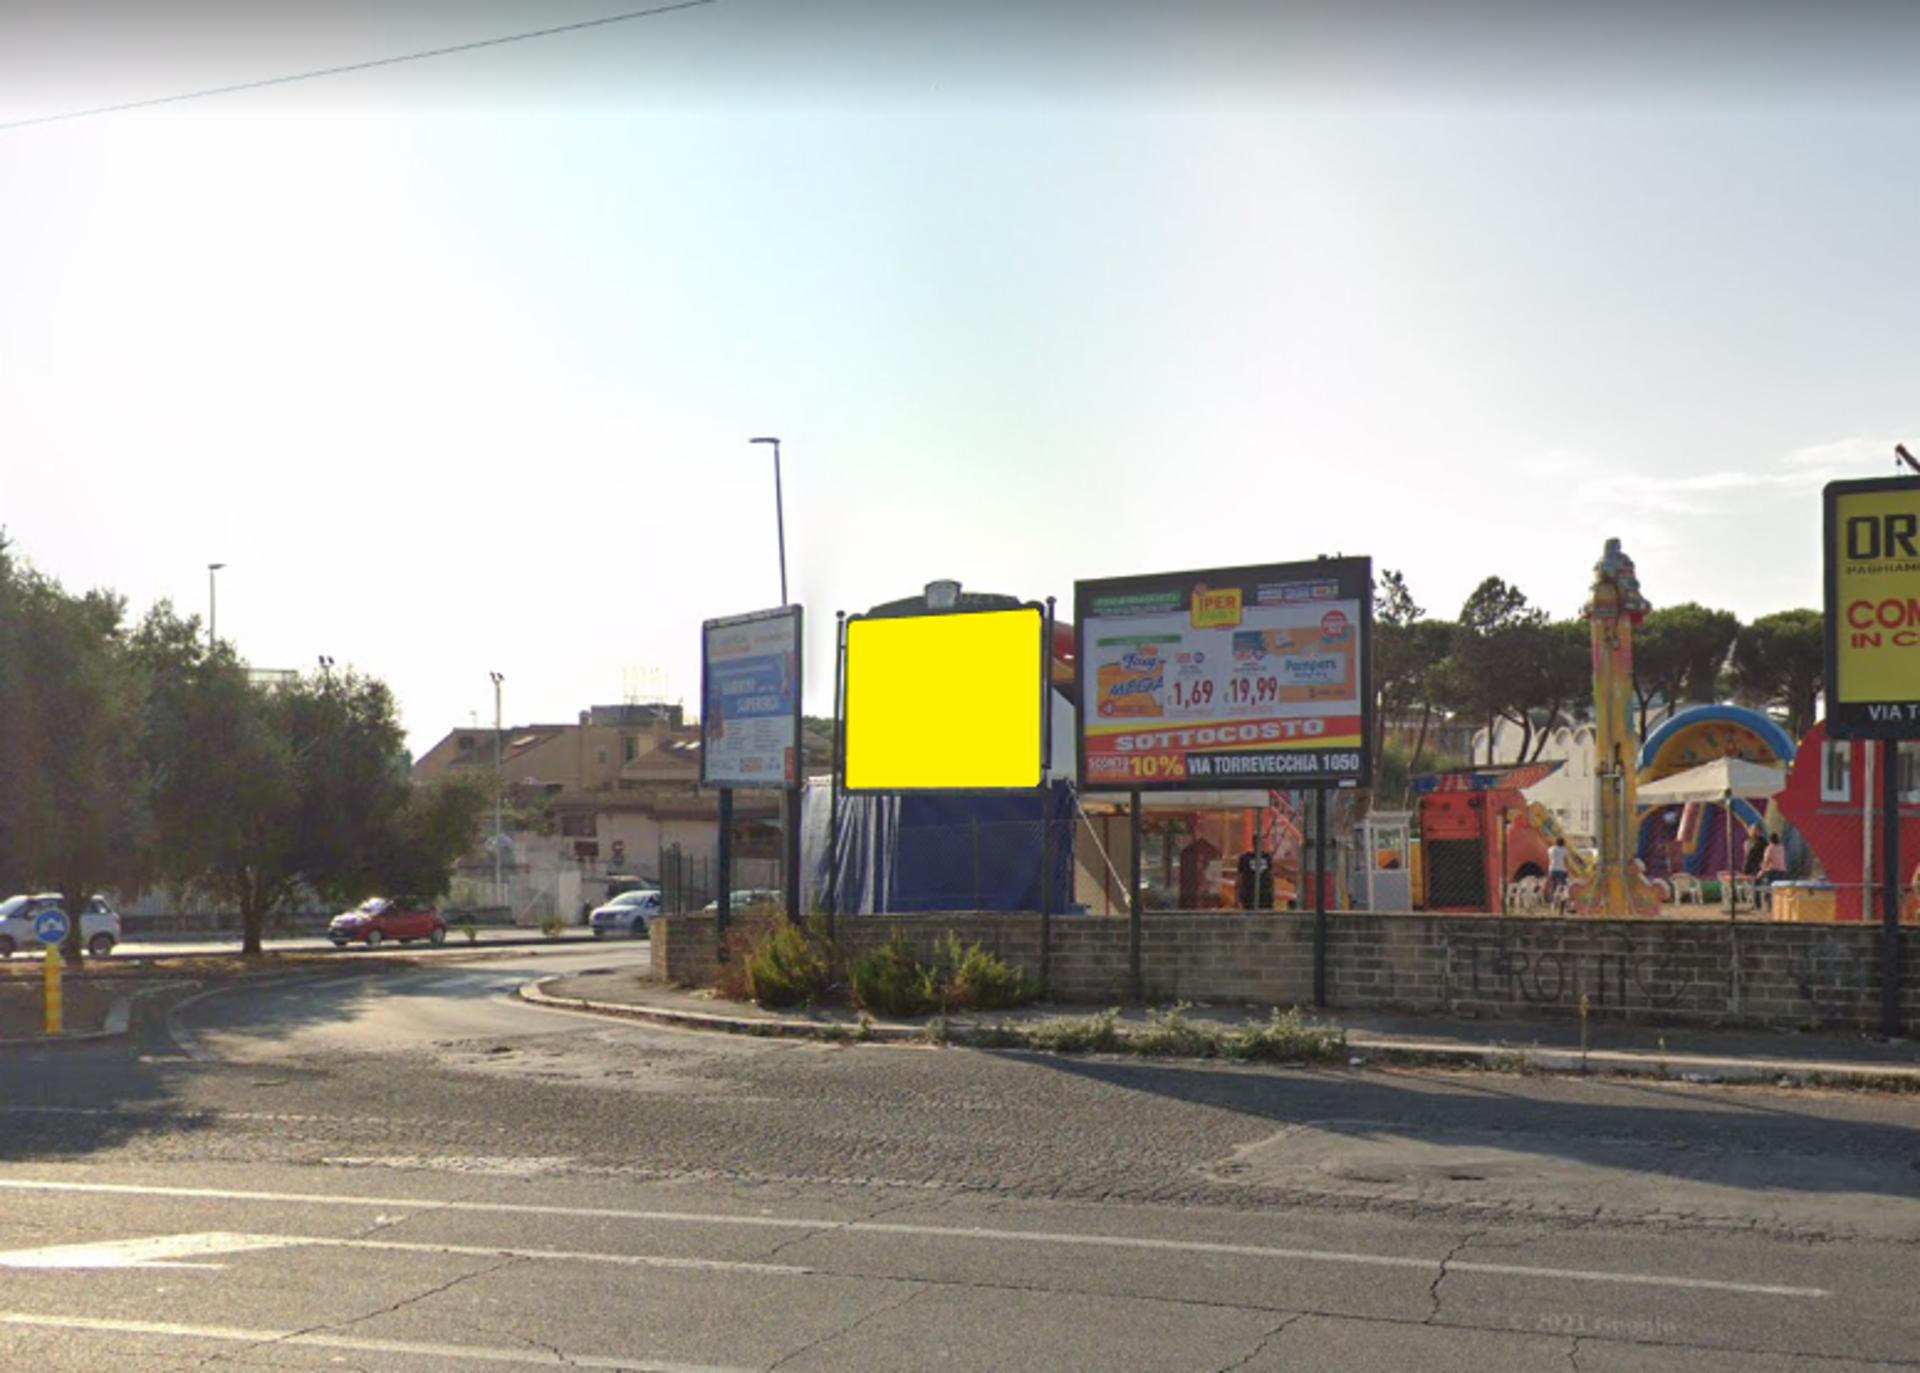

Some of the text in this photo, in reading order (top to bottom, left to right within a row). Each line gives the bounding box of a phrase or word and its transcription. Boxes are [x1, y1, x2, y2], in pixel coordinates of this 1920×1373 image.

[1851, 633, 1882, 648] IN
[1174, 680, 1213, 708] 1,69
[1230, 676, 1277, 705] 19,99
[1868, 704, 1920, 720] VIA T
[1115, 719, 1325, 752] SOTTOCOSTO
[1130, 755, 1184, 776] 10%
[1188, 754, 1359, 775] VIA TORREVECCHIA 1050
